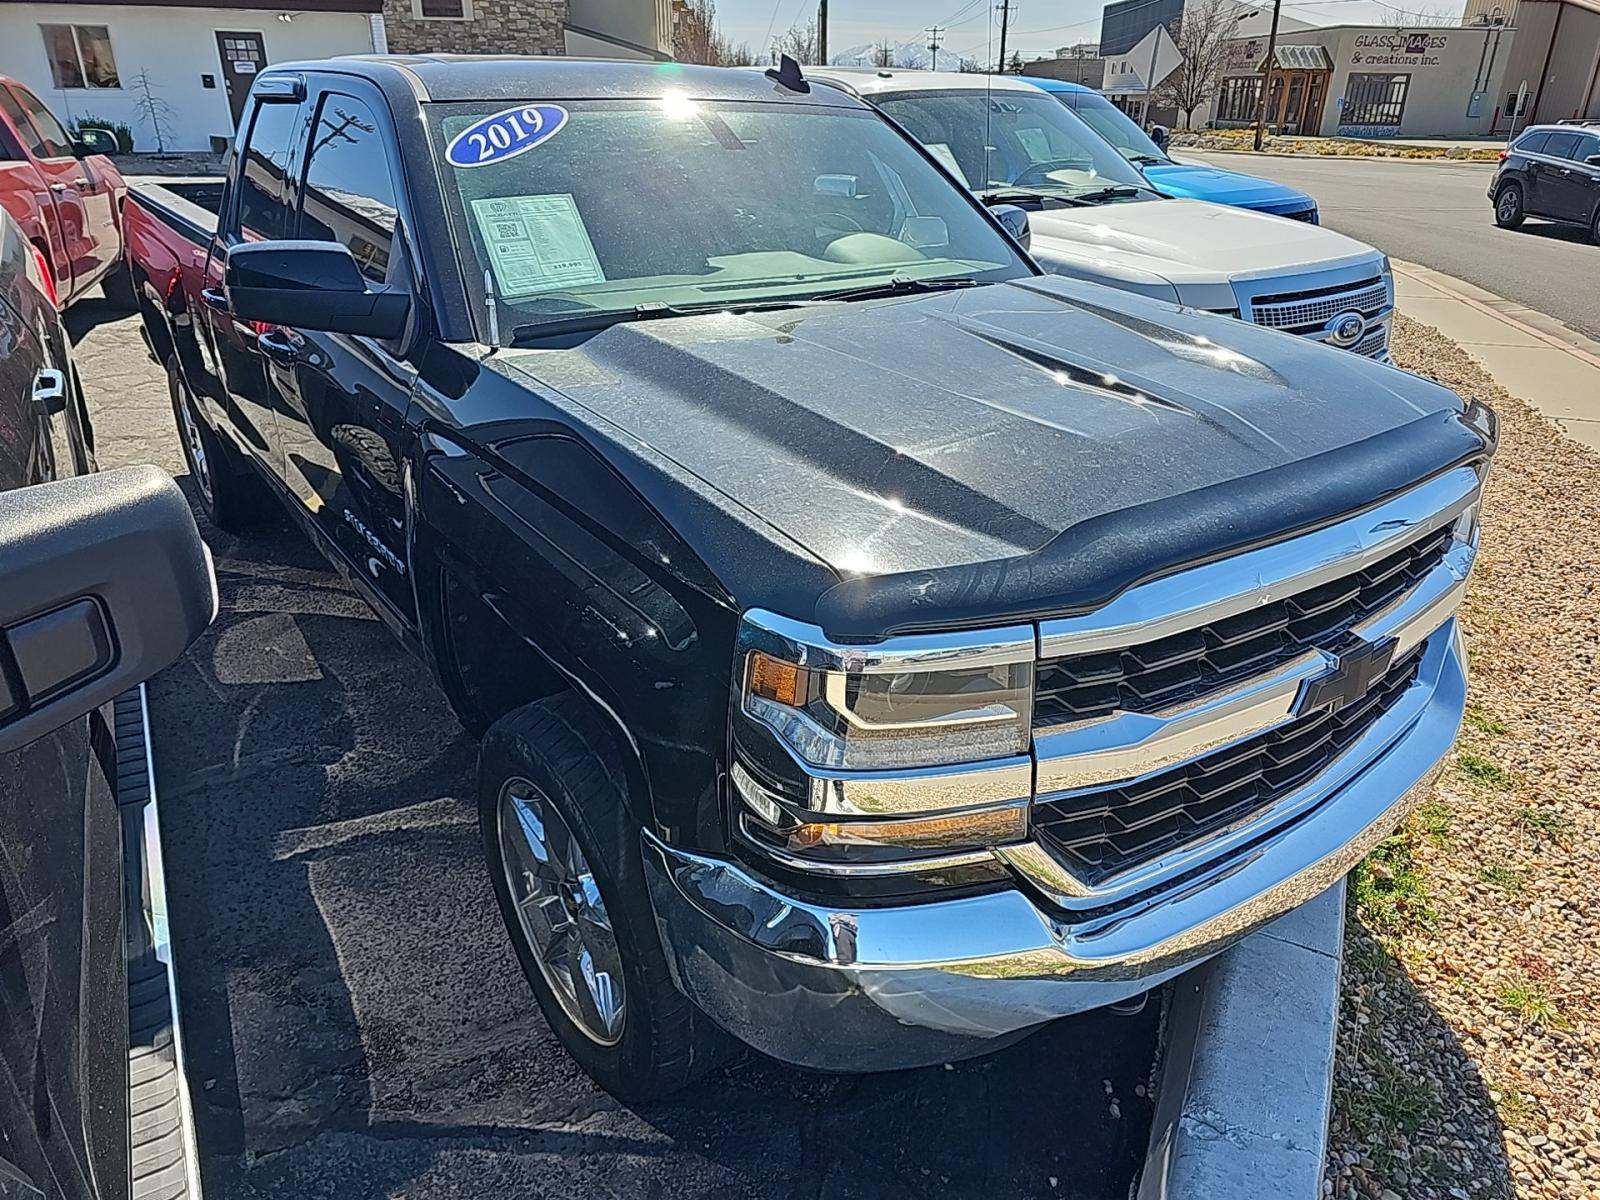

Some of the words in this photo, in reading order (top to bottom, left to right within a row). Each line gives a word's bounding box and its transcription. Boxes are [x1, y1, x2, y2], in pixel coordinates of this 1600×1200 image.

[1354, 35, 1395, 48] GLASS
[1398, 34, 1447, 49] IMAGES
[1351, 51, 1362, 63] &
[1365, 53, 1417, 65] creations
[1420, 54, 1440, 65] inc.
[468, 108, 544, 161] 2019
